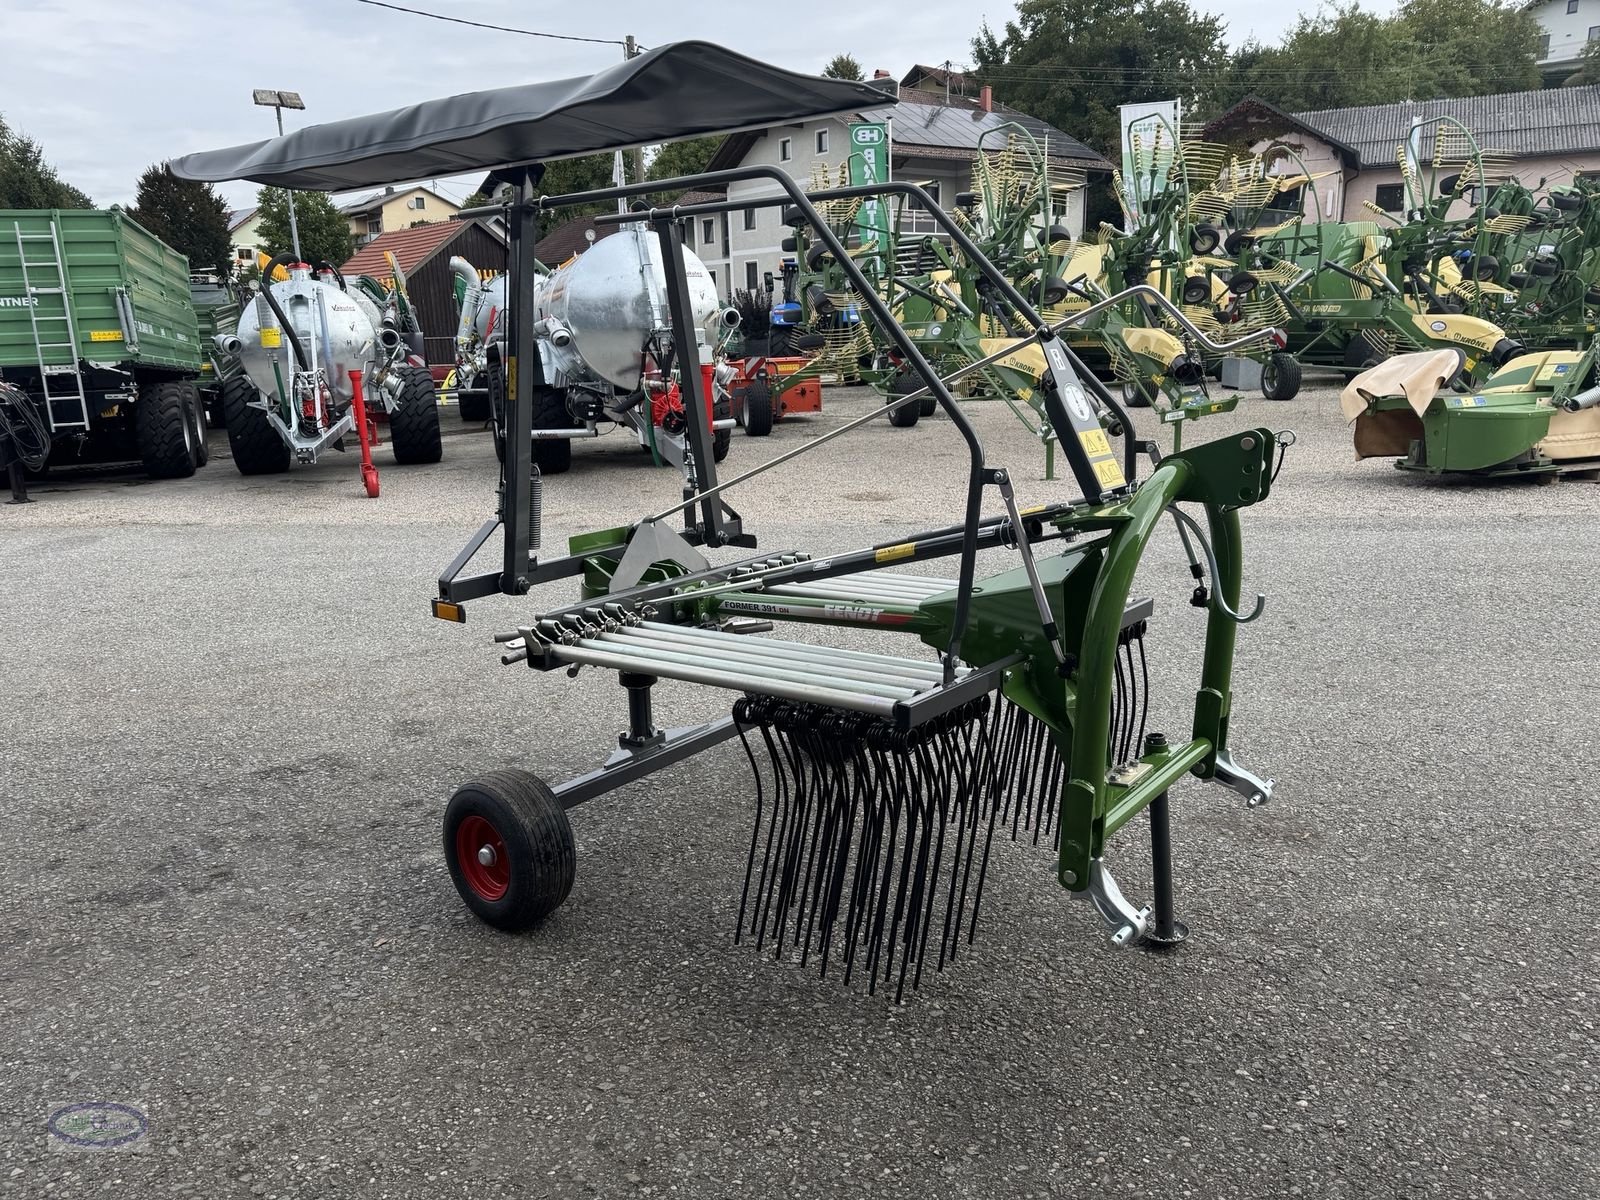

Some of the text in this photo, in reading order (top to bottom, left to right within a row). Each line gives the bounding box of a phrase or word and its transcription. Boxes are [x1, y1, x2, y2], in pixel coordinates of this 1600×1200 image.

[1460, 336, 1487, 349] KRONE
[1015, 361, 1036, 374] KRONE
[724, 601, 760, 612] FORMER
[761, 604, 777, 613] 391
[823, 604, 884, 622] FENDT
